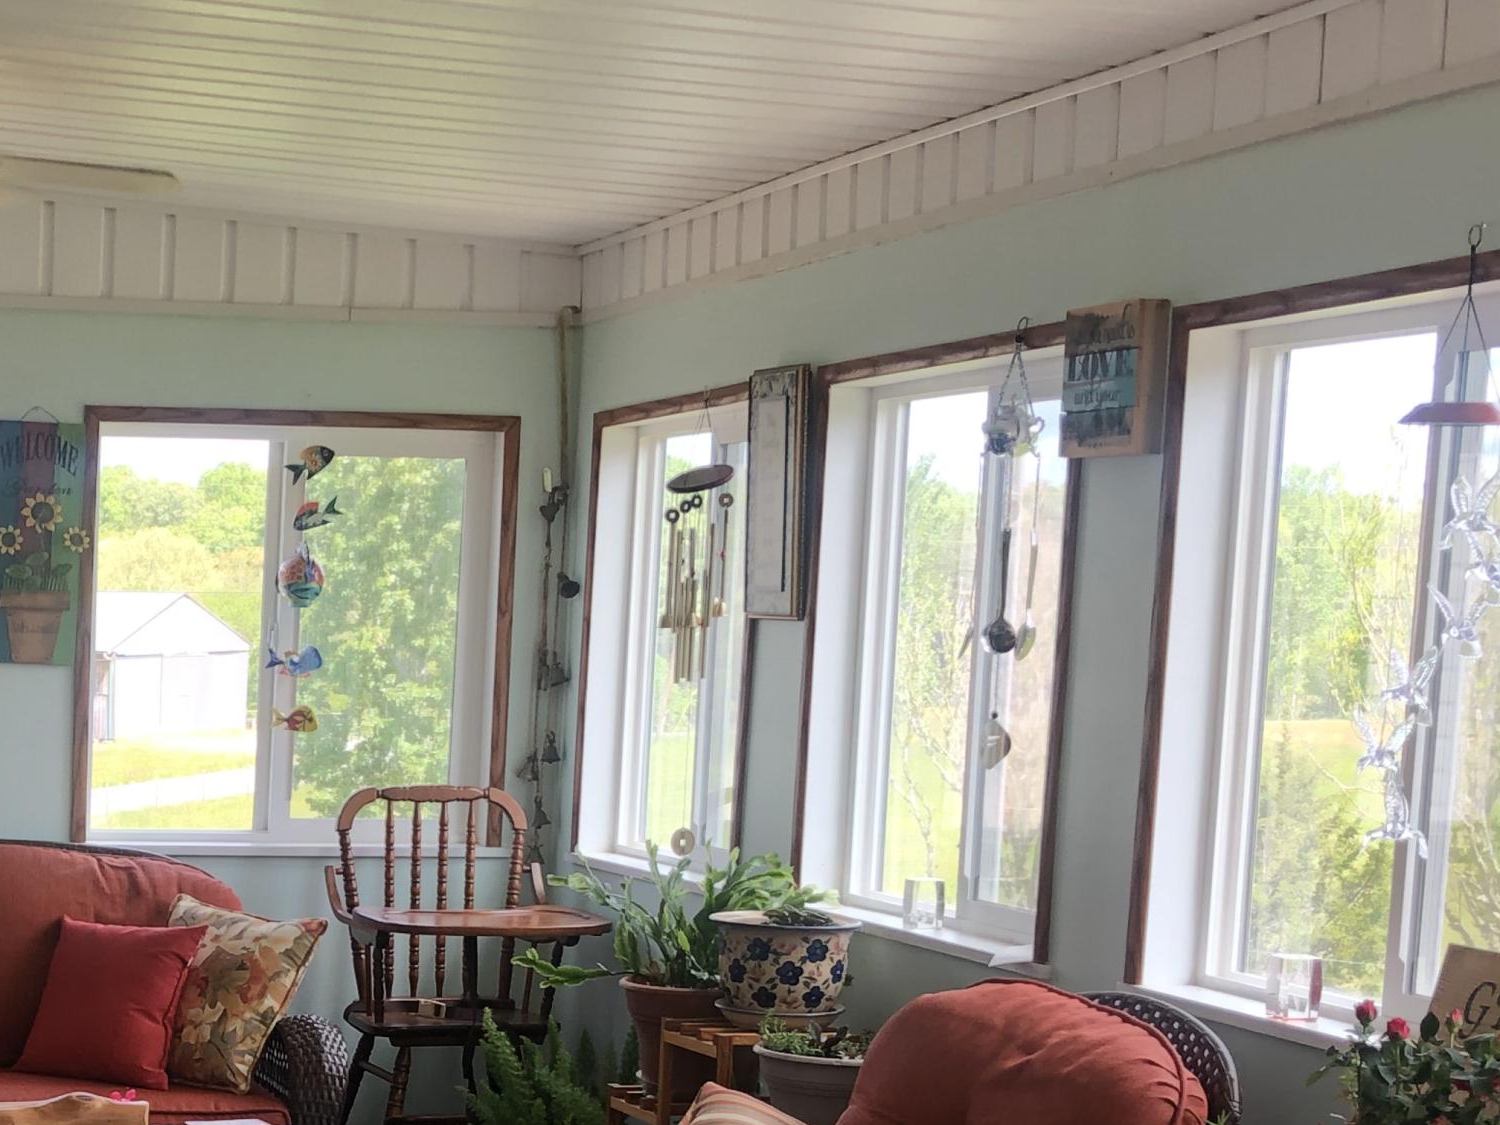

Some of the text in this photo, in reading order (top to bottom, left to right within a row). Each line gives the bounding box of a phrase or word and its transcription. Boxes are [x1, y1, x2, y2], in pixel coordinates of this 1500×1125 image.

[1067, 348, 1135, 382] LOVE
[0, 431, 79, 477] WELCOME
[1458, 981, 1500, 1039] G
